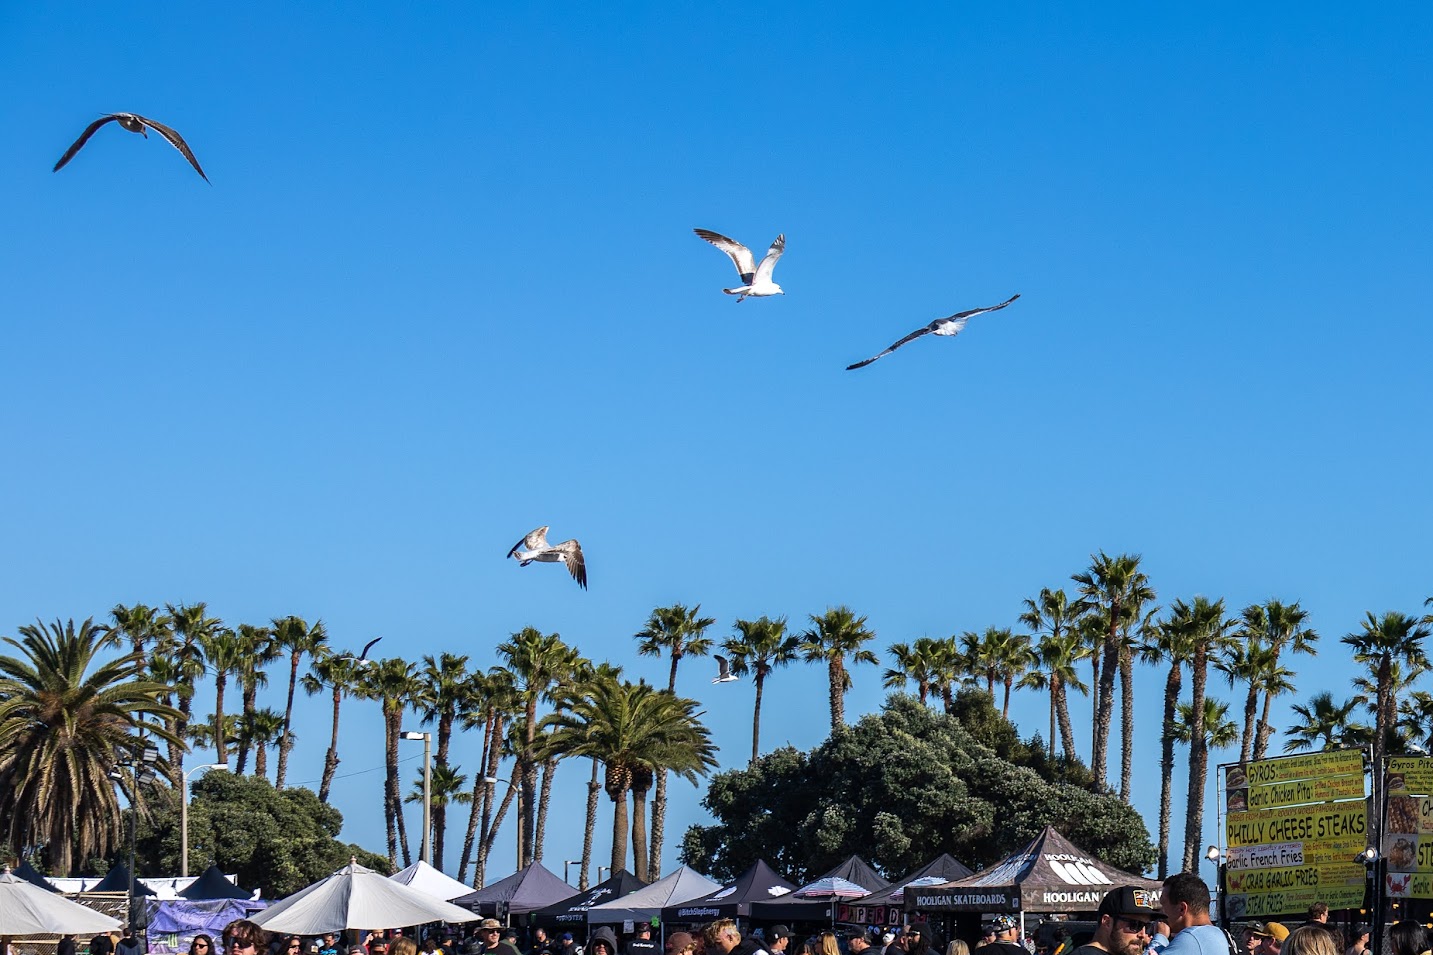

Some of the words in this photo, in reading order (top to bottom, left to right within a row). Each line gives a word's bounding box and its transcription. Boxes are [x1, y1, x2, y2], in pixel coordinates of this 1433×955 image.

[1248, 763, 1279, 783] GYROS:
[1391, 760, 1415, 771] Gyros
[1250, 788, 1268, 806] Garlic
[1270, 784, 1295, 804] Chicken
[1229, 822, 1265, 845] PHILLY
[1269, 816, 1312, 841] CHEESE
[1318, 814, 1365, 837] STEAKS
[1044, 853, 1094, 866] HOOLIGAN
[1227, 854, 1248, 869] Garlic
[1250, 851, 1278, 867] French
[1281, 850, 1303, 864] Fries
[1245, 872, 1263, 890] CRAB
[1266, 870, 1293, 889] GARLIC
[1296, 867, 1319, 887] FRIES
[1413, 876, 1430, 894] Garlic
[916, 895, 951, 906] HOOLIGAN
[953, 894, 1006, 905] SKATEBOARDS
[1043, 892, 1100, 903] HOOLIGAN
[1246, 895, 1265, 915] STEAK
[838, 905, 885, 923] PAPER
